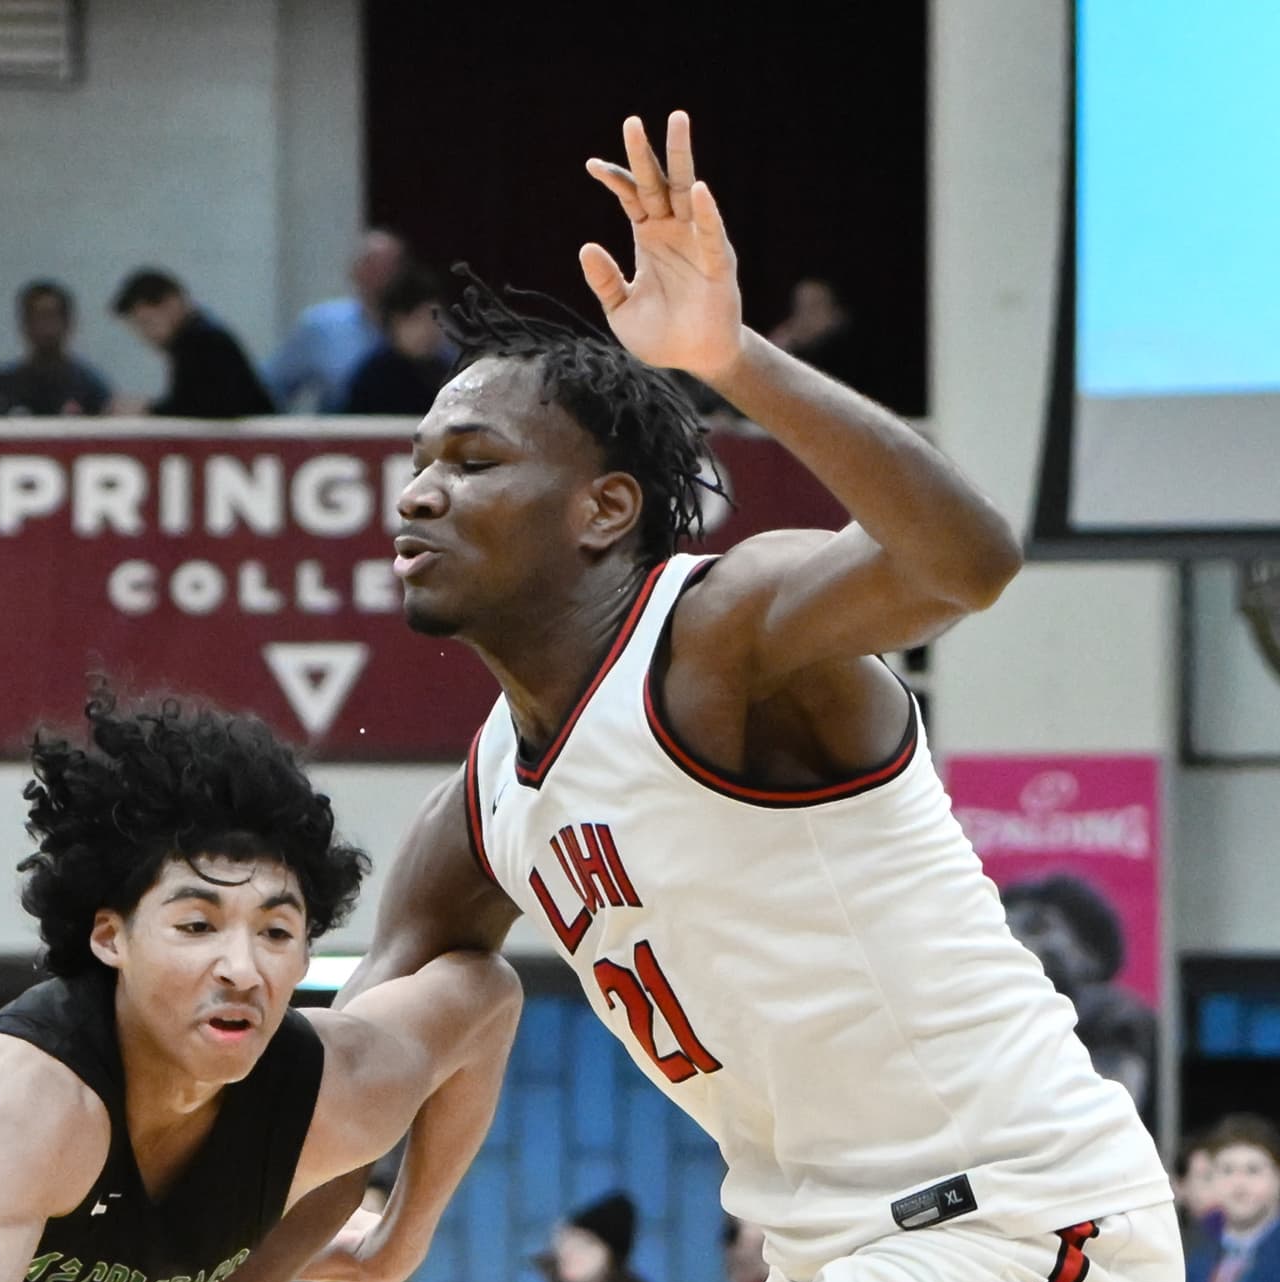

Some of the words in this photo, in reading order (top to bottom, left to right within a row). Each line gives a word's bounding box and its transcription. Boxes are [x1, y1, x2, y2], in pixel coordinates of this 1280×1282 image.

[107, 559, 403, 617] COLLE
[593, 939, 724, 1084] 21
[944, 1189, 964, 1207] XL
